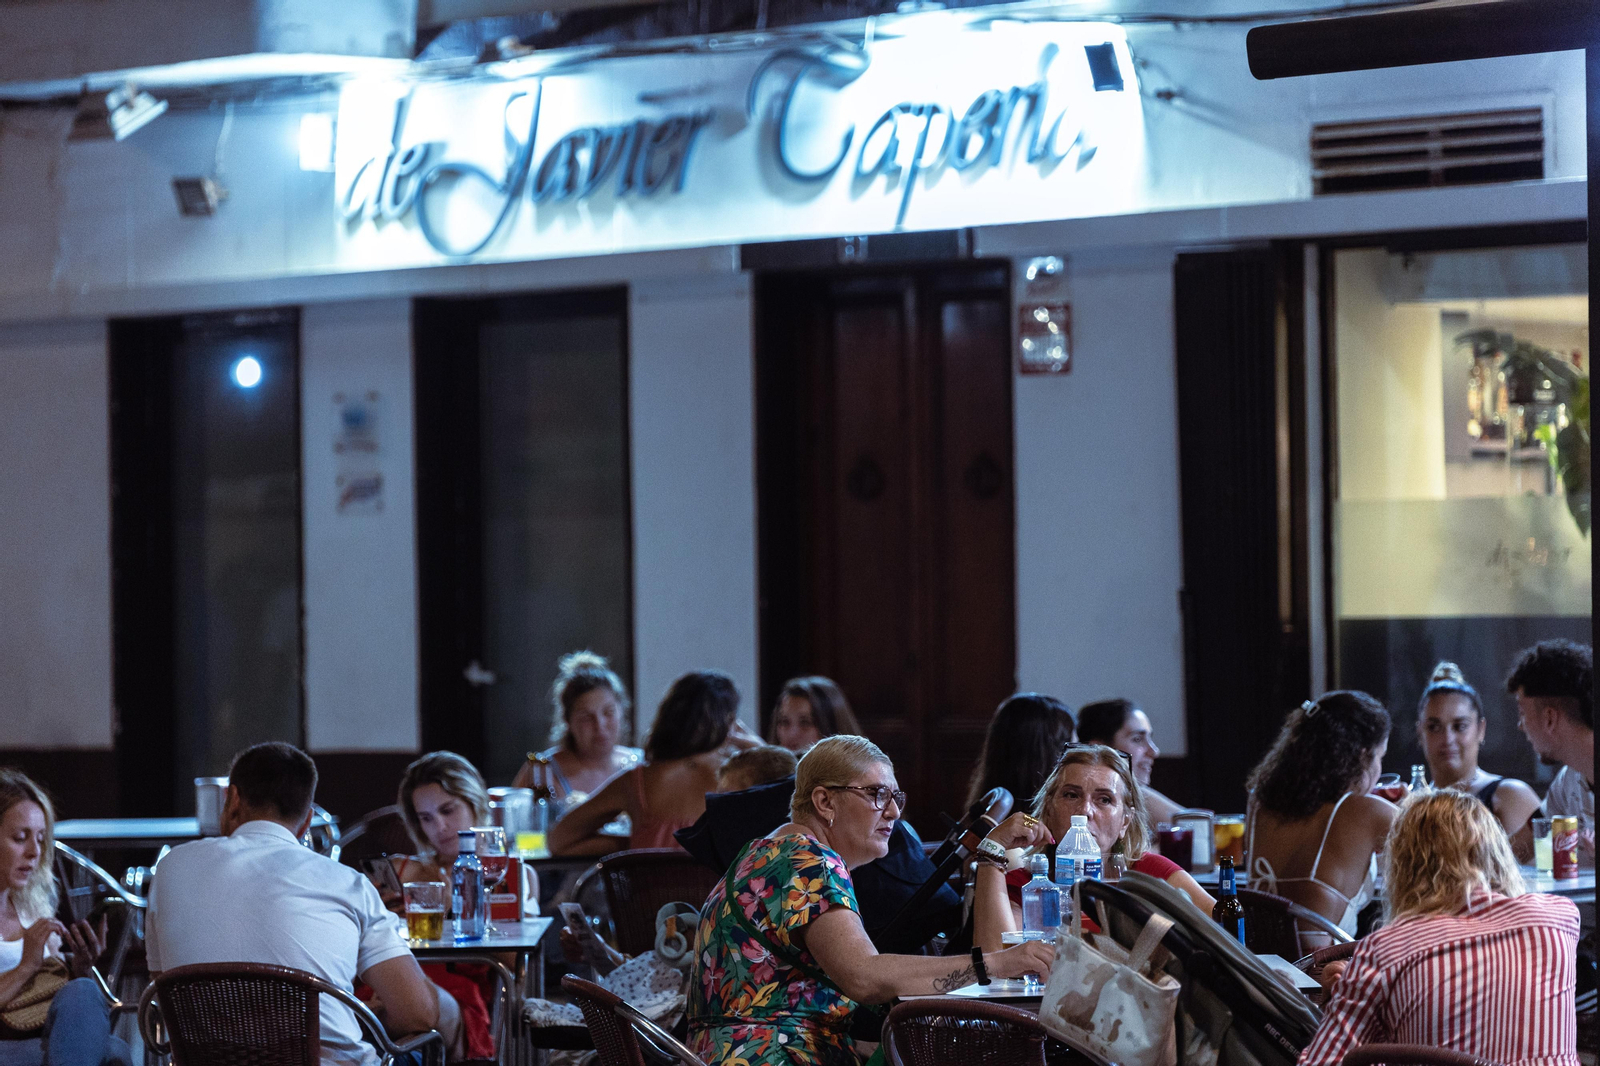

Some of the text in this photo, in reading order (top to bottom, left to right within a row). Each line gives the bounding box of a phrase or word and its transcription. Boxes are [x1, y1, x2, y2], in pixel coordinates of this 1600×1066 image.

[414, 83, 709, 257] Javier
[1264, 1023, 1301, 1058] ABC DESIG
